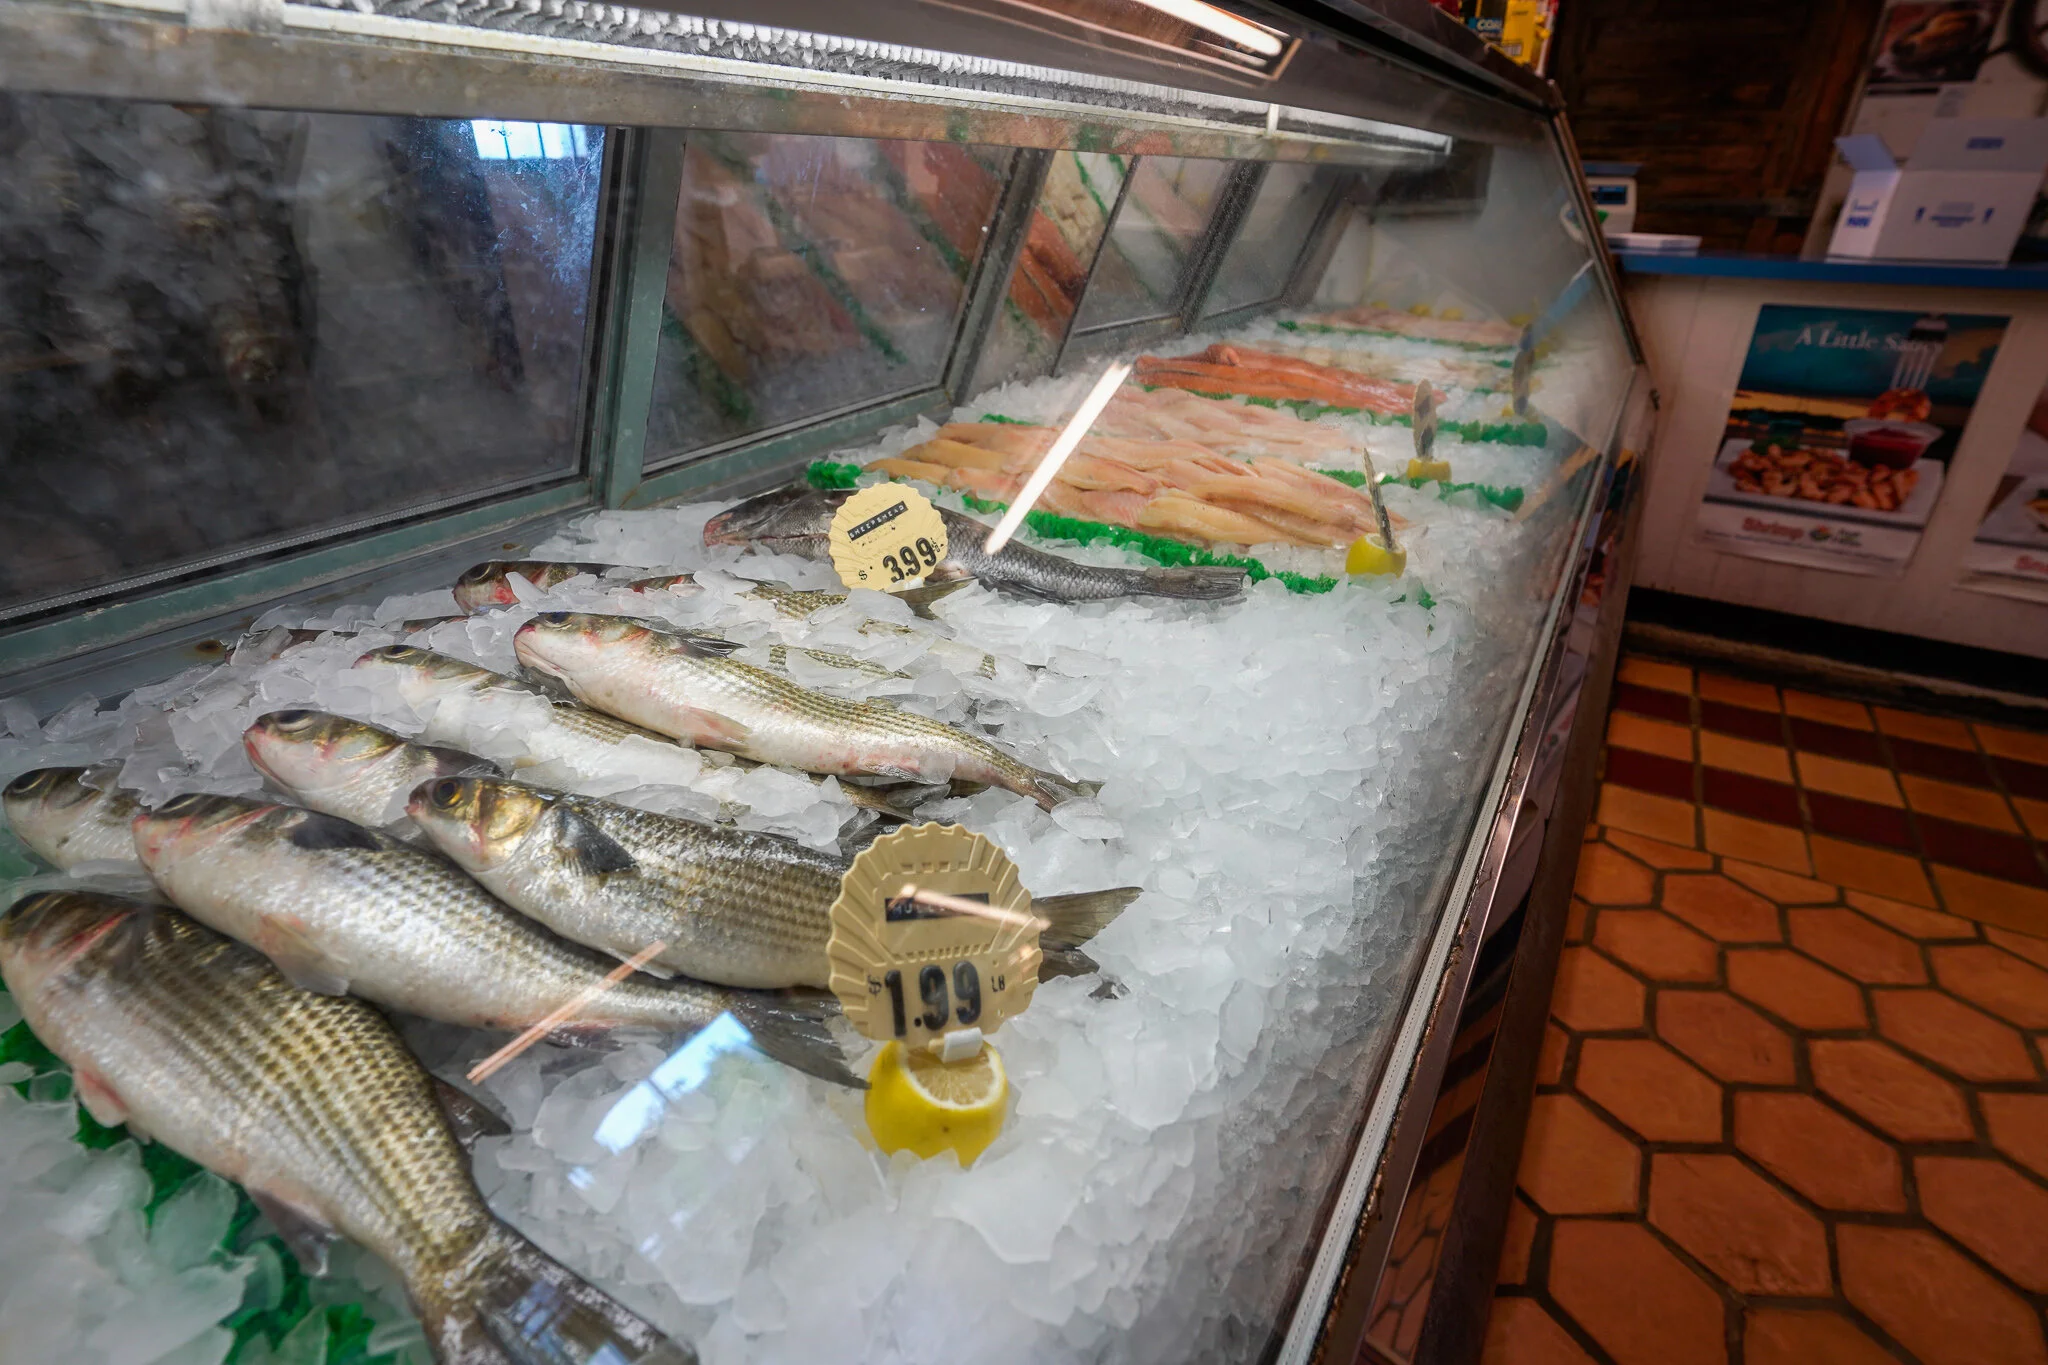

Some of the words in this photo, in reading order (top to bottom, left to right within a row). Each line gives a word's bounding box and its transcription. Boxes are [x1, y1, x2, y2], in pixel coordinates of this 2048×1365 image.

[1795, 327, 1811, 346] A
[848, 504, 905, 538] SHEEPSHEAD
[858, 570, 868, 581] $
[883, 537, 936, 583] 3.99
[867, 974, 882, 997] $
[884, 960, 982, 1037] 1.99
[991, 975, 1006, 993] LB
